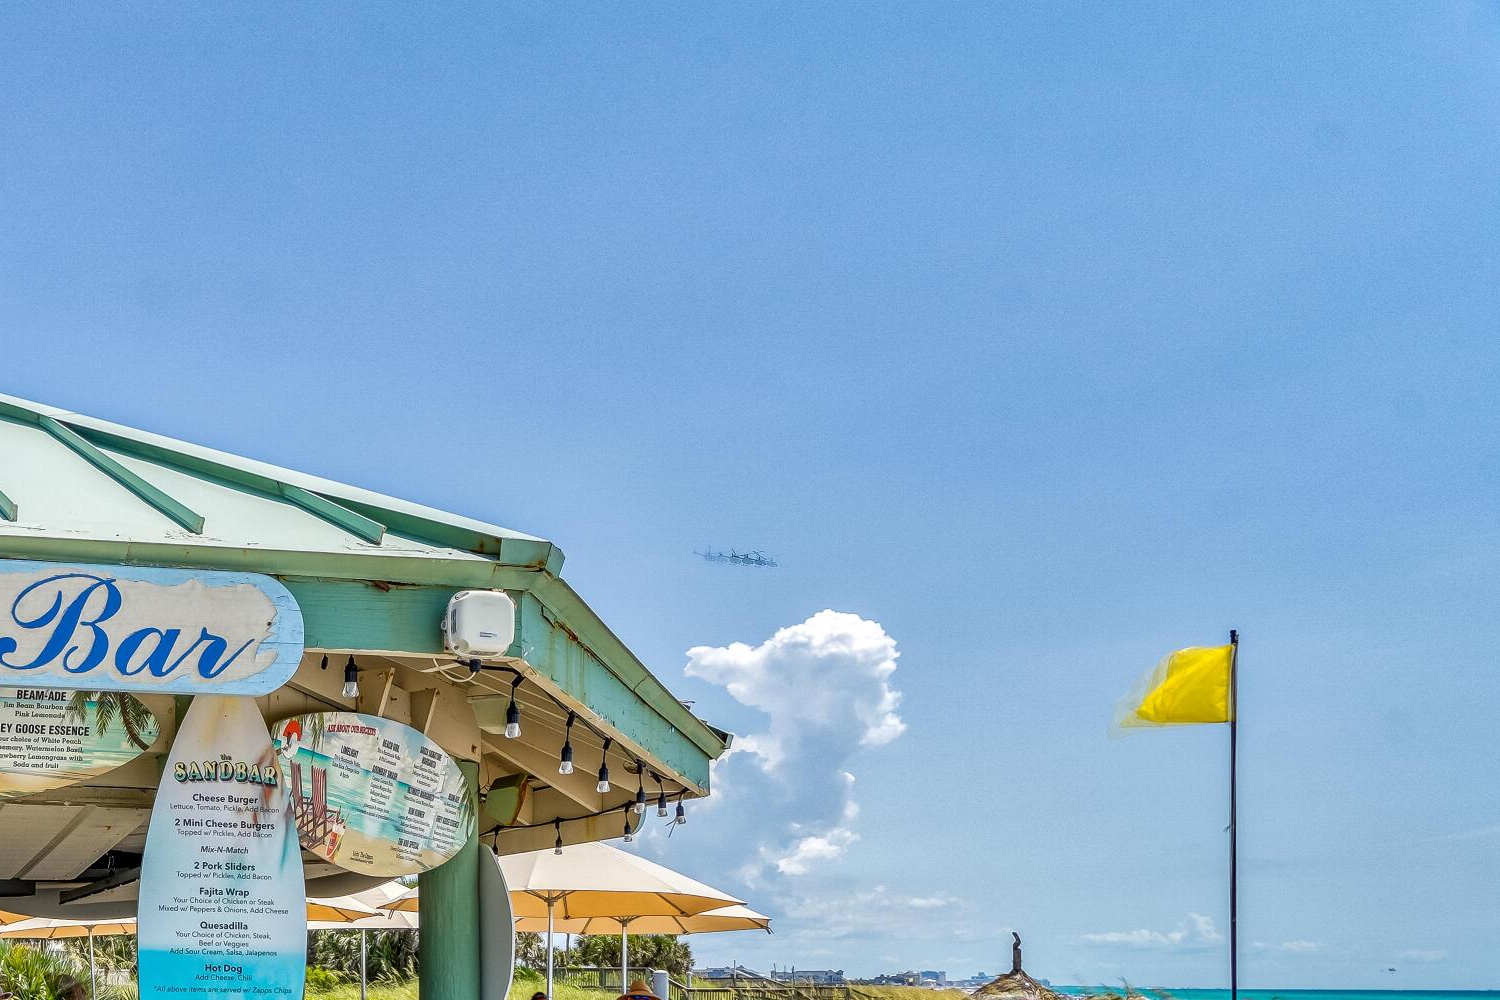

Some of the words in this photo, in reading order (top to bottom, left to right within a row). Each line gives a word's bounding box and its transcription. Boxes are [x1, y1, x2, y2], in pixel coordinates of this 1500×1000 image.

[16, 724, 46, 734] GOOSE
[49, 725, 90, 736] ESSENCE
[174, 760, 278, 787] SANDBAR
[192, 794, 225, 802] Cheese
[228, 795, 258, 805] Burger
[183, 819, 203, 827] Mini
[206, 820, 238, 828] Cheese
[240, 821, 275, 831] Burgers
[177, 828, 202, 836] Topped
[200, 846, 248, 854] Mix-N-Match
[202, 862, 222, 870] Pork
[225, 862, 255, 871] Sliders
[200, 888, 224, 897] Fajita
[226, 888, 250, 898] Wrap
[258, 898, 274, 906] Steak
[224, 906, 248, 914] Onions,
[200, 922, 248, 930] Quesadilla
[205, 964, 221, 972] Hot
[224, 964, 242, 974] Dog
